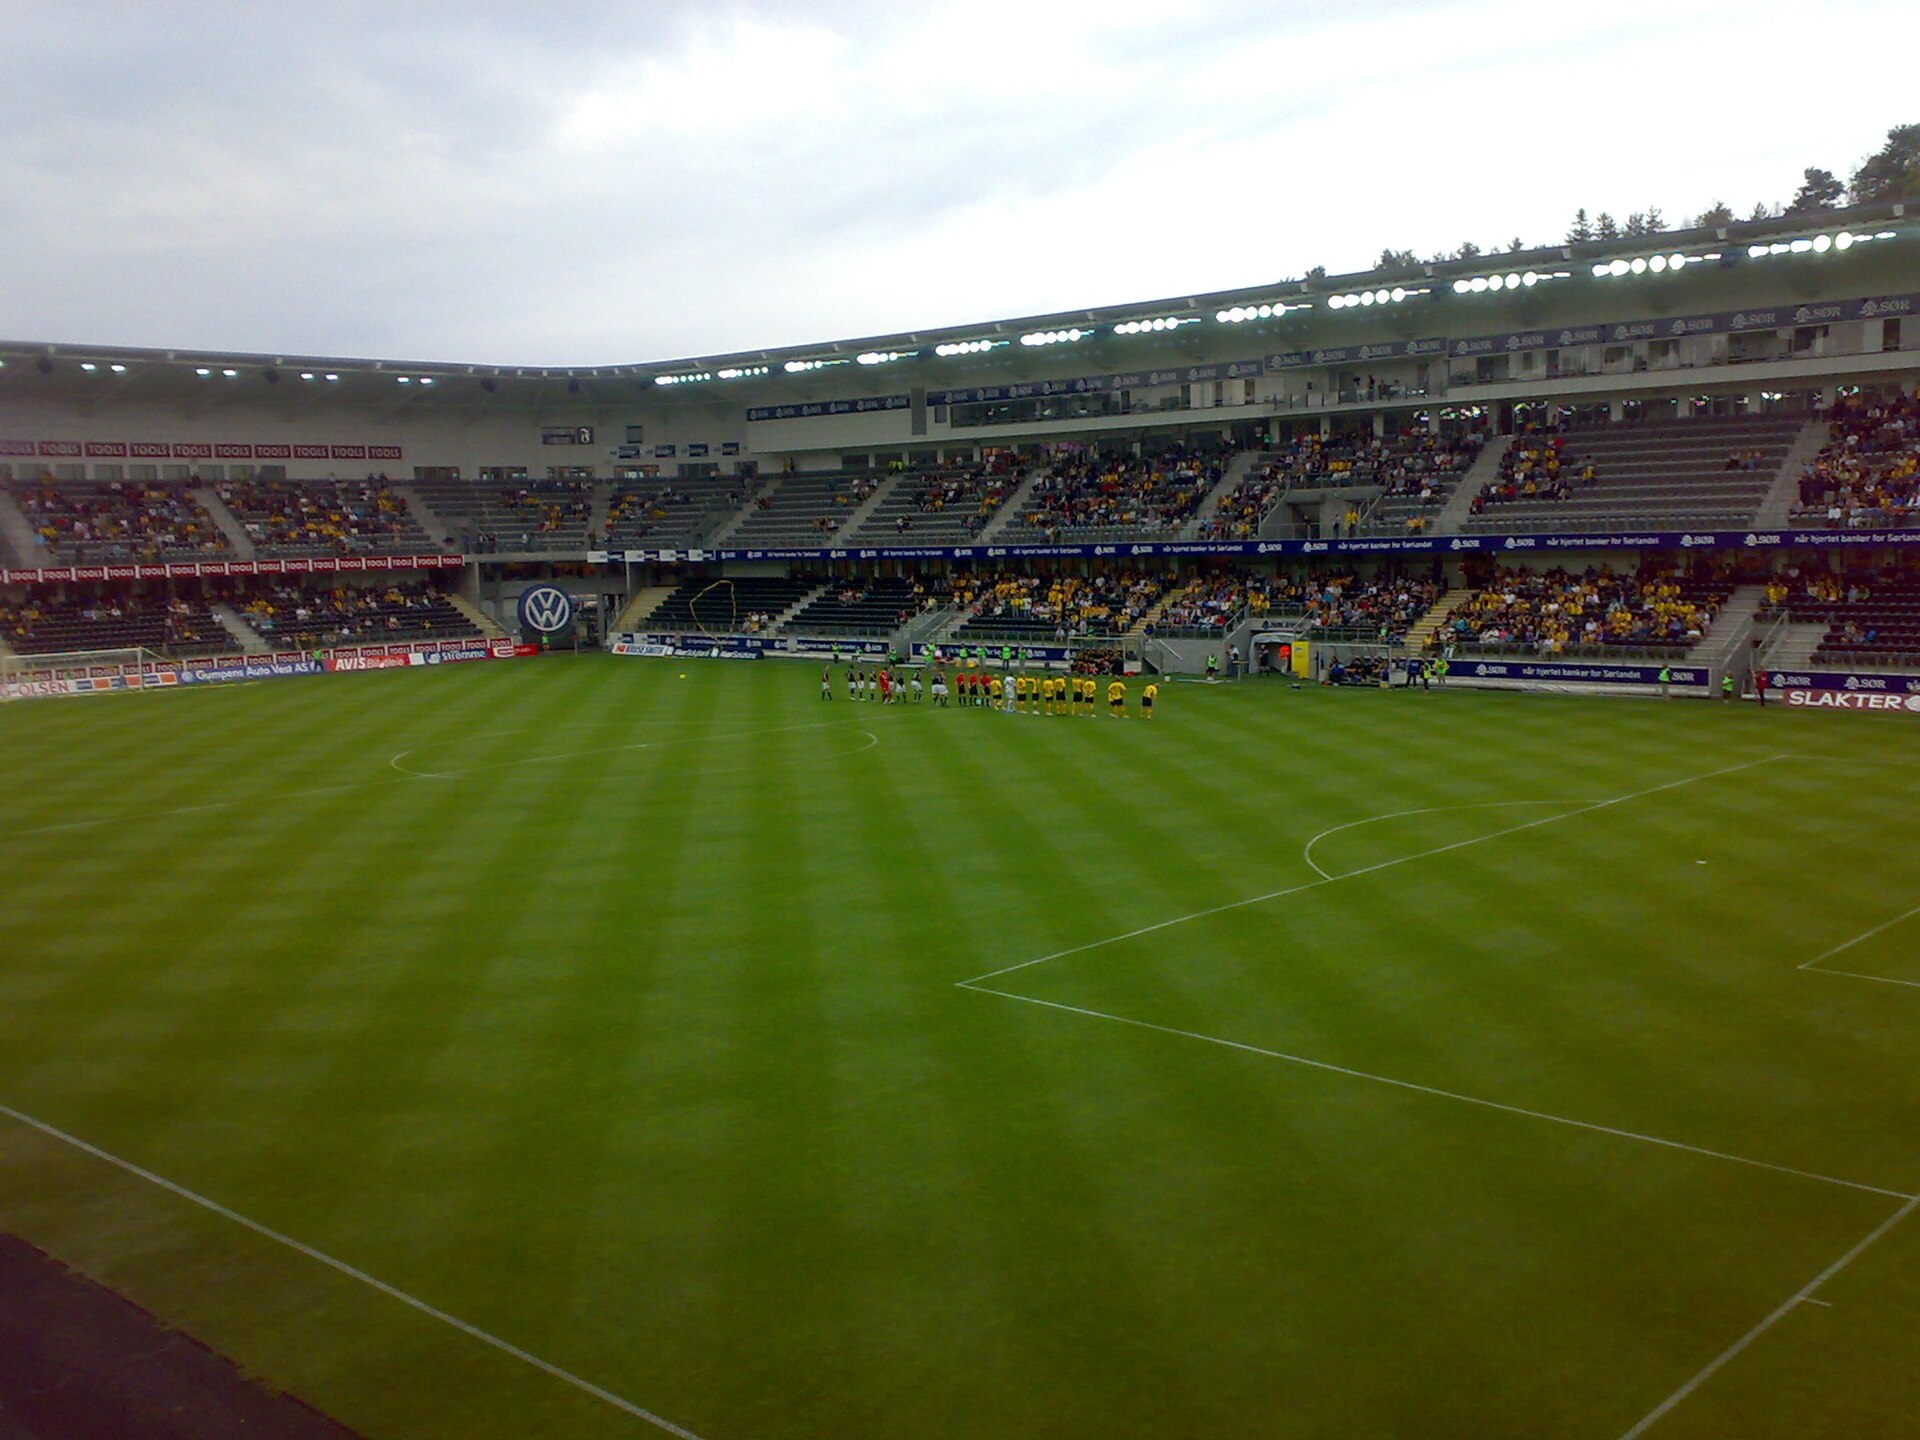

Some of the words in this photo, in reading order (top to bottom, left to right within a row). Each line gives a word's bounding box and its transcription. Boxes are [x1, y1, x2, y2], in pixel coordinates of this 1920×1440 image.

[196, 669, 244, 682] Gumpens
[246, 665, 271, 677] Auto
[270, 663, 293, 675] Vest
[294, 662, 309, 673] AS
[335, 657, 367, 671] AVIS
[1789, 691, 1903, 710] SLAKTER
